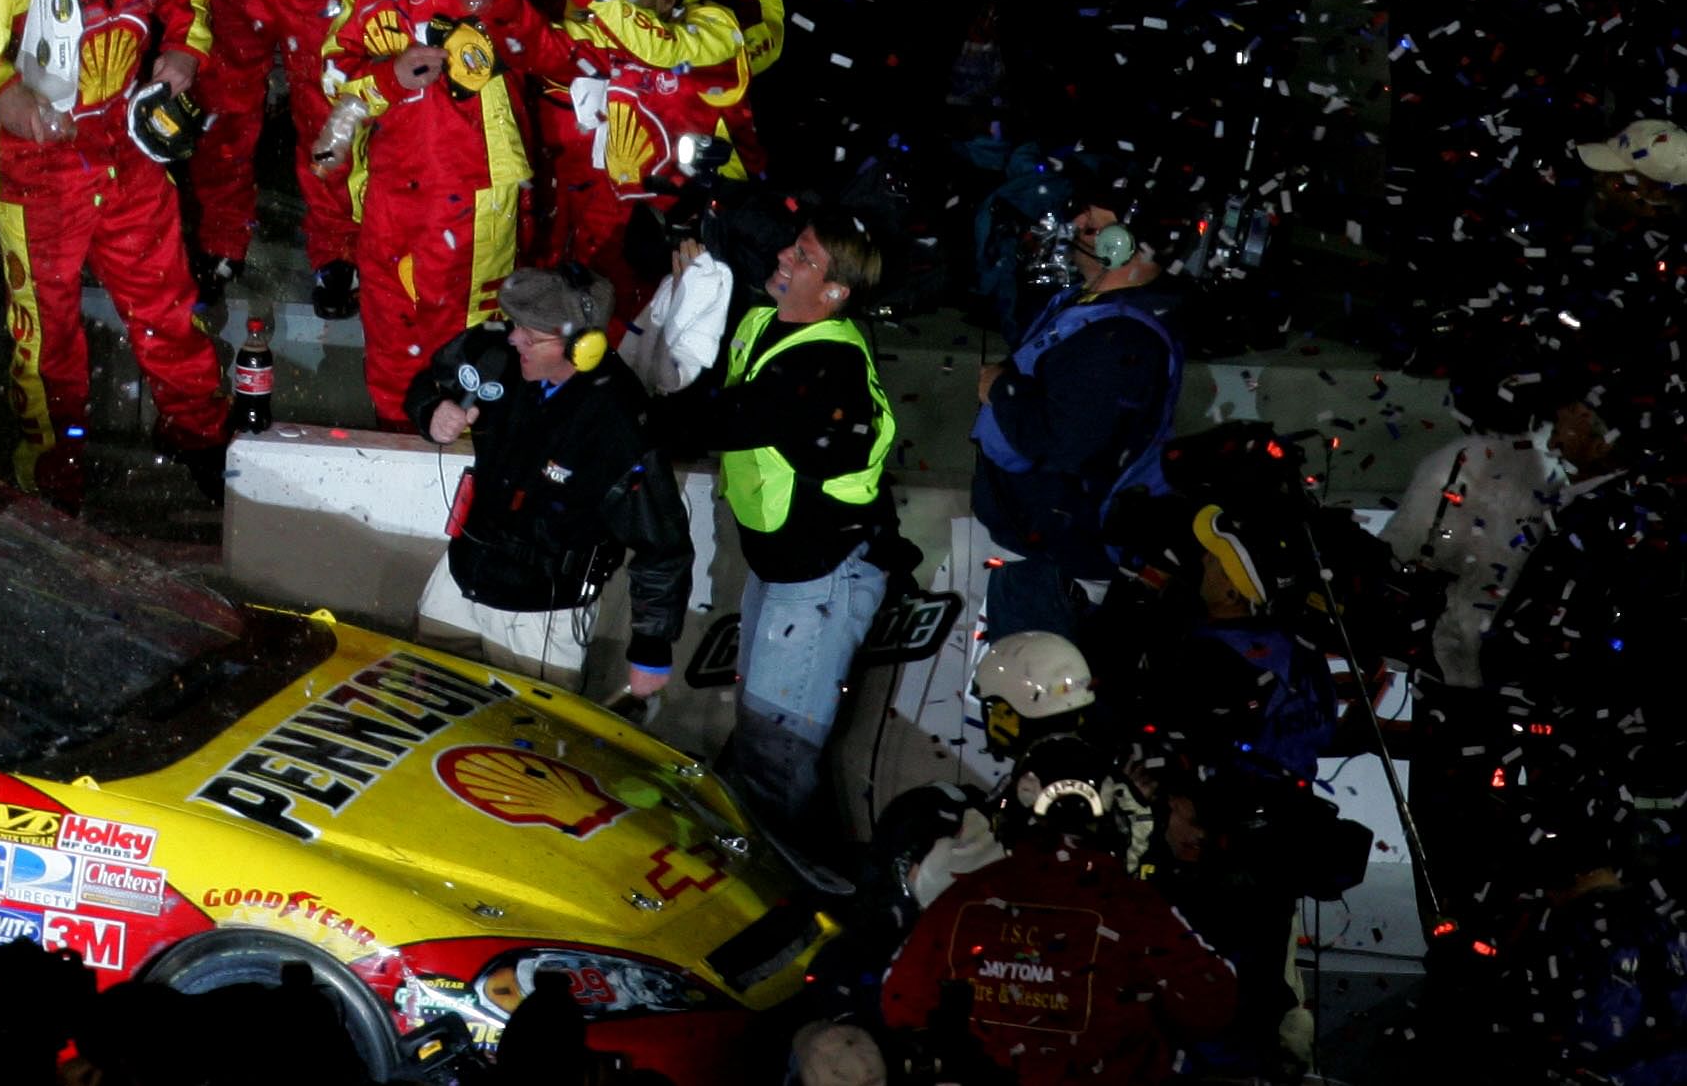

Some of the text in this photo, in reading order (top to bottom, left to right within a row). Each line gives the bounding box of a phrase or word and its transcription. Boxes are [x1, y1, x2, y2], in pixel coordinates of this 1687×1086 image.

[20, 836, 54, 848] WEAR
[64, 817, 153, 859] Holley
[85, 861, 158, 893] Checkers
[8, 889, 75, 908] DIRECTV
[203, 888, 374, 948] GOODYEAR
[46, 916, 118, 964] 3M
[980, 961, 1055, 983] DAYTONA
